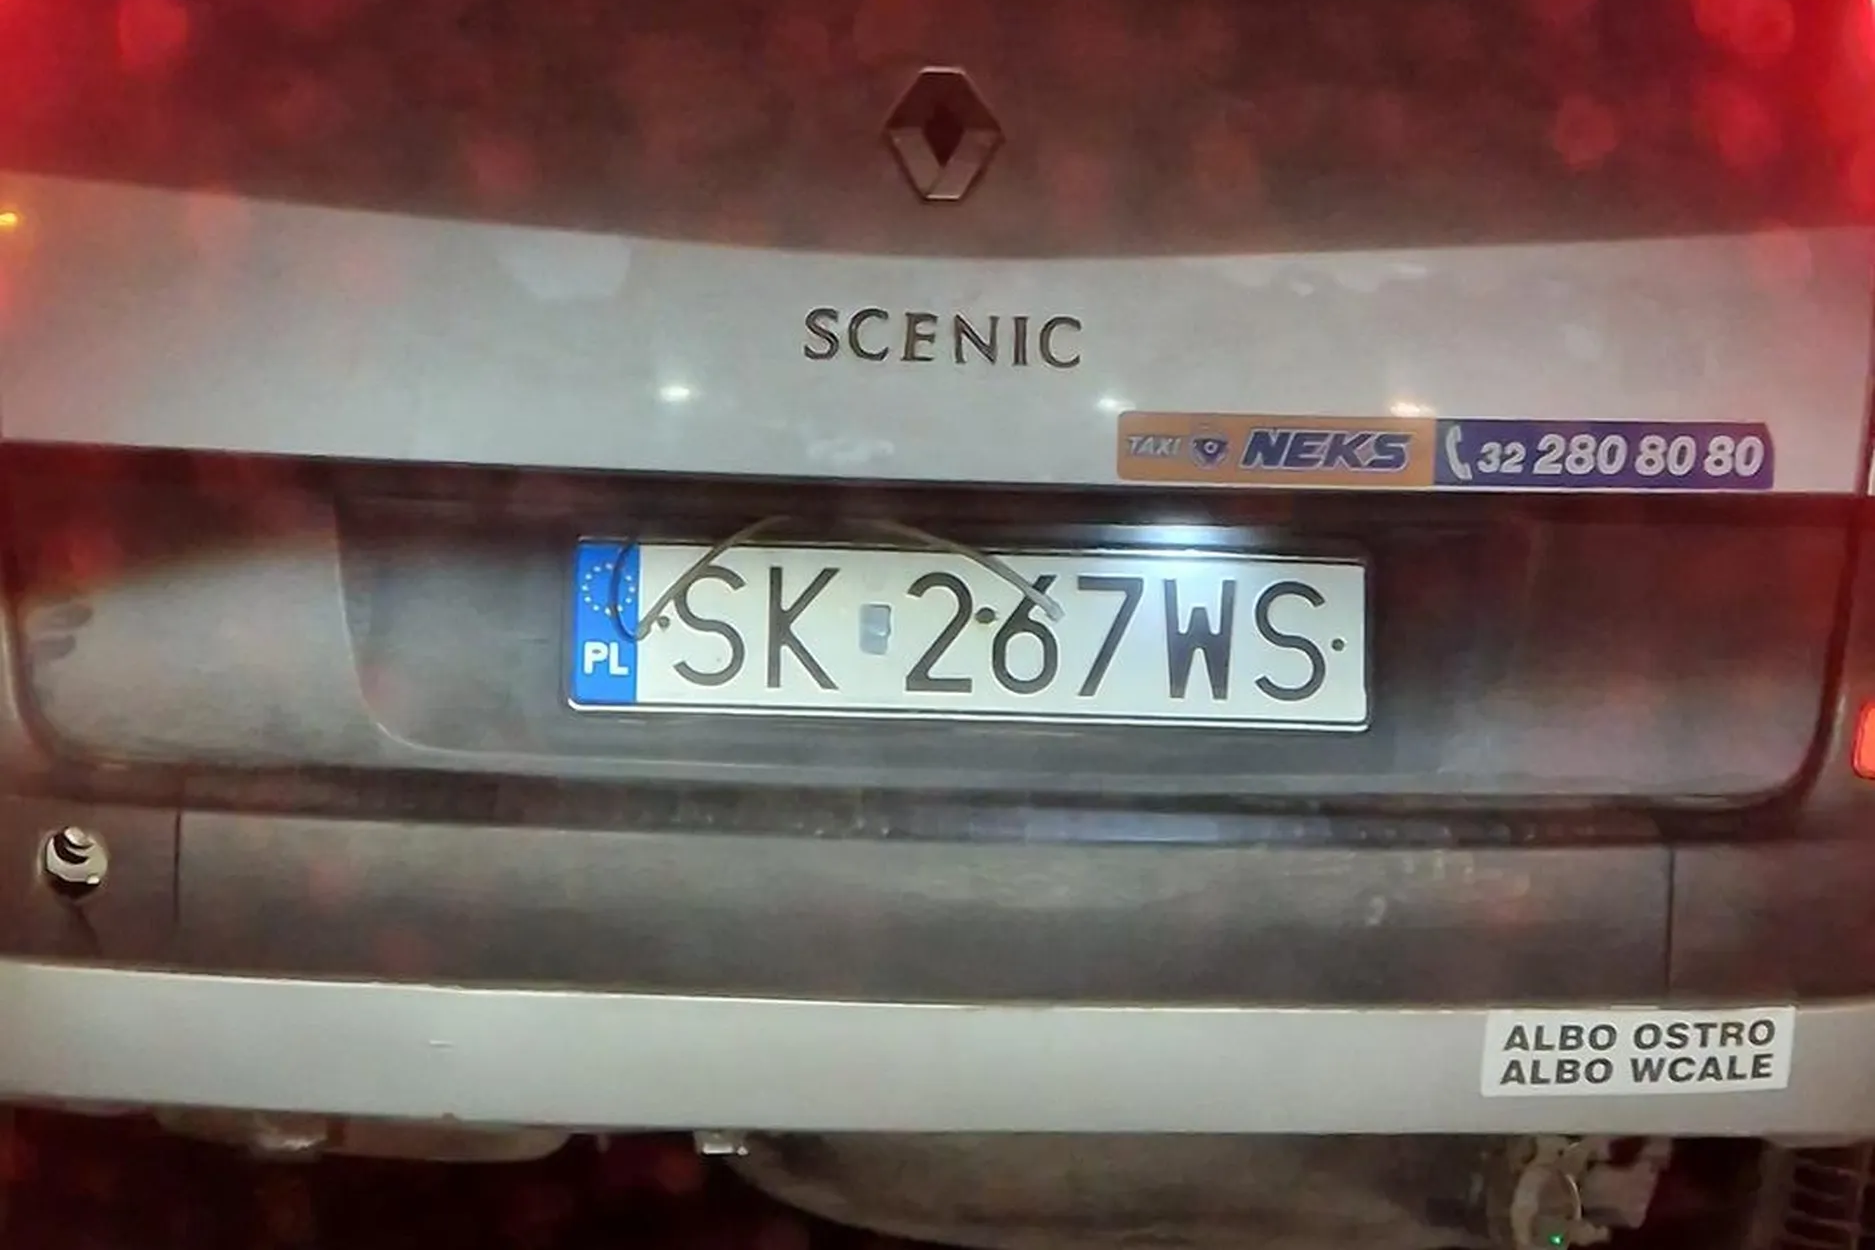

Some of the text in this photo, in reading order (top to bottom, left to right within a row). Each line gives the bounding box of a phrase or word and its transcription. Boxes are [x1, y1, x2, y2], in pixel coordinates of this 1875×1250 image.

[803, 306, 1082, 369] SCENIC
[1126, 427, 1416, 473] TAXI NEKS
[1476, 433, 1765, 477] 32 280 80 80
[672, 564, 1329, 703] SK 267WS
[582, 641, 629, 676] PL
[1502, 1018, 1776, 1052] ALBO OSTRO
[1500, 1052, 1774, 1086] ALBO WCALE
